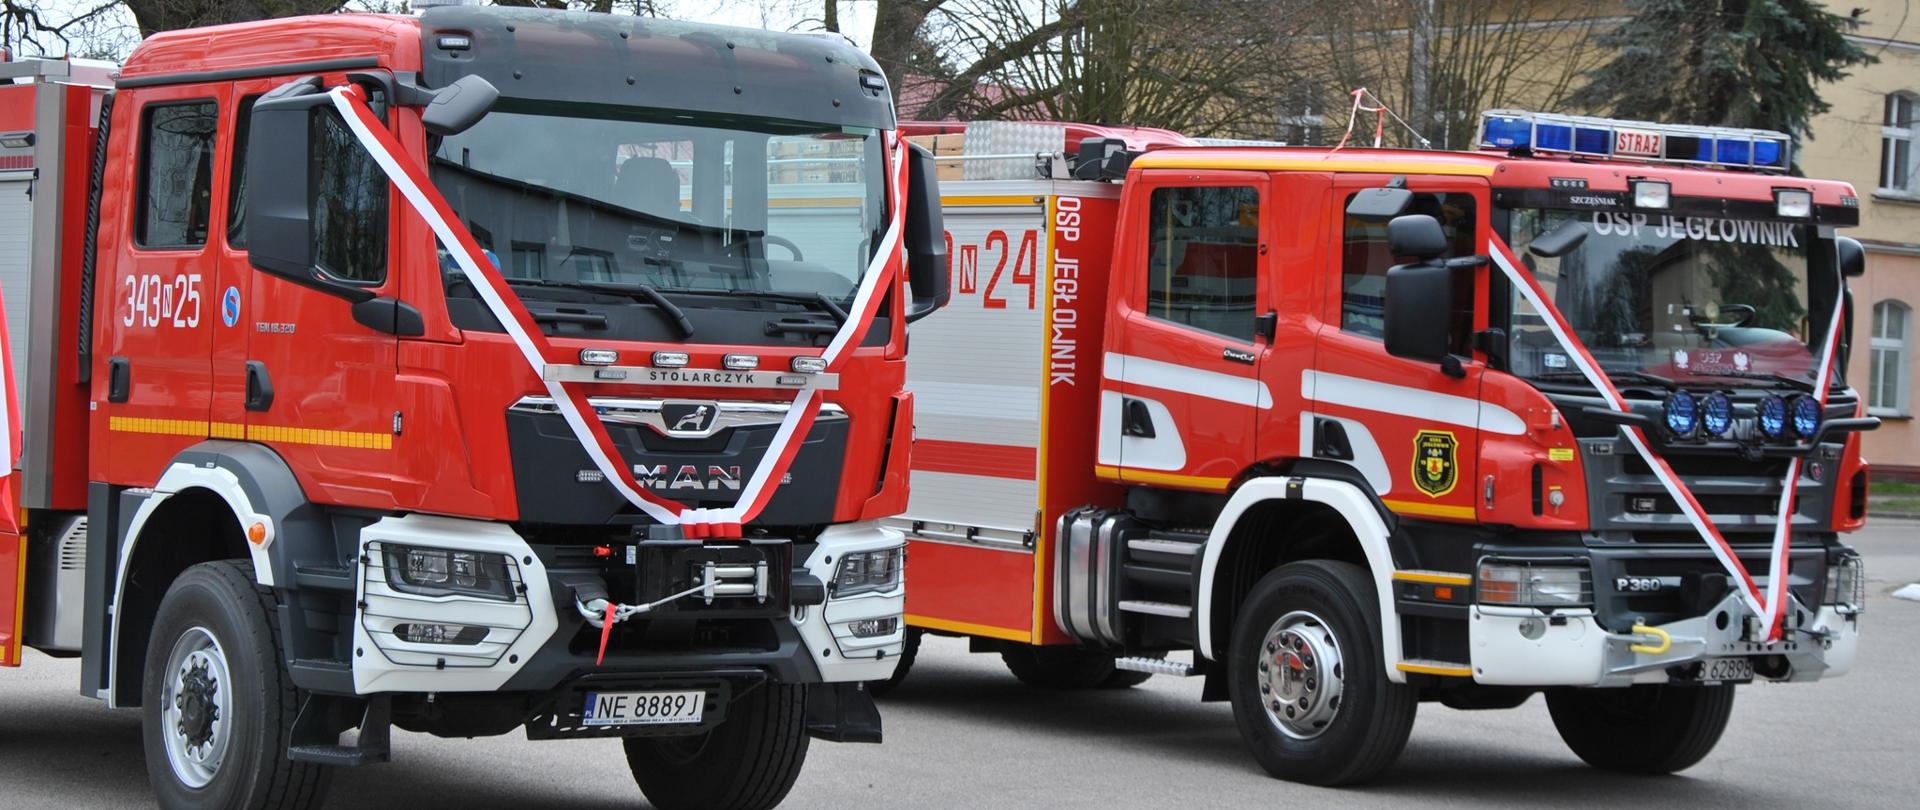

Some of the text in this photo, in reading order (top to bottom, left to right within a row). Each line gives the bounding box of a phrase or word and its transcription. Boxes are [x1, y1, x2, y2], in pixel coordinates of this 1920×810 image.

[1056, 196, 1081, 242] OSP
[1593, 211, 1799, 248] OSP JEGŁOWNIK
[1050, 248, 1079, 386] JEGŁOWNIK
[649, 370, 755, 384] STOLARCZYK
[633, 464, 741, 490] MAN
[1711, 660, 1753, 679] 62898
[598, 694, 698, 718] NE 8889J
